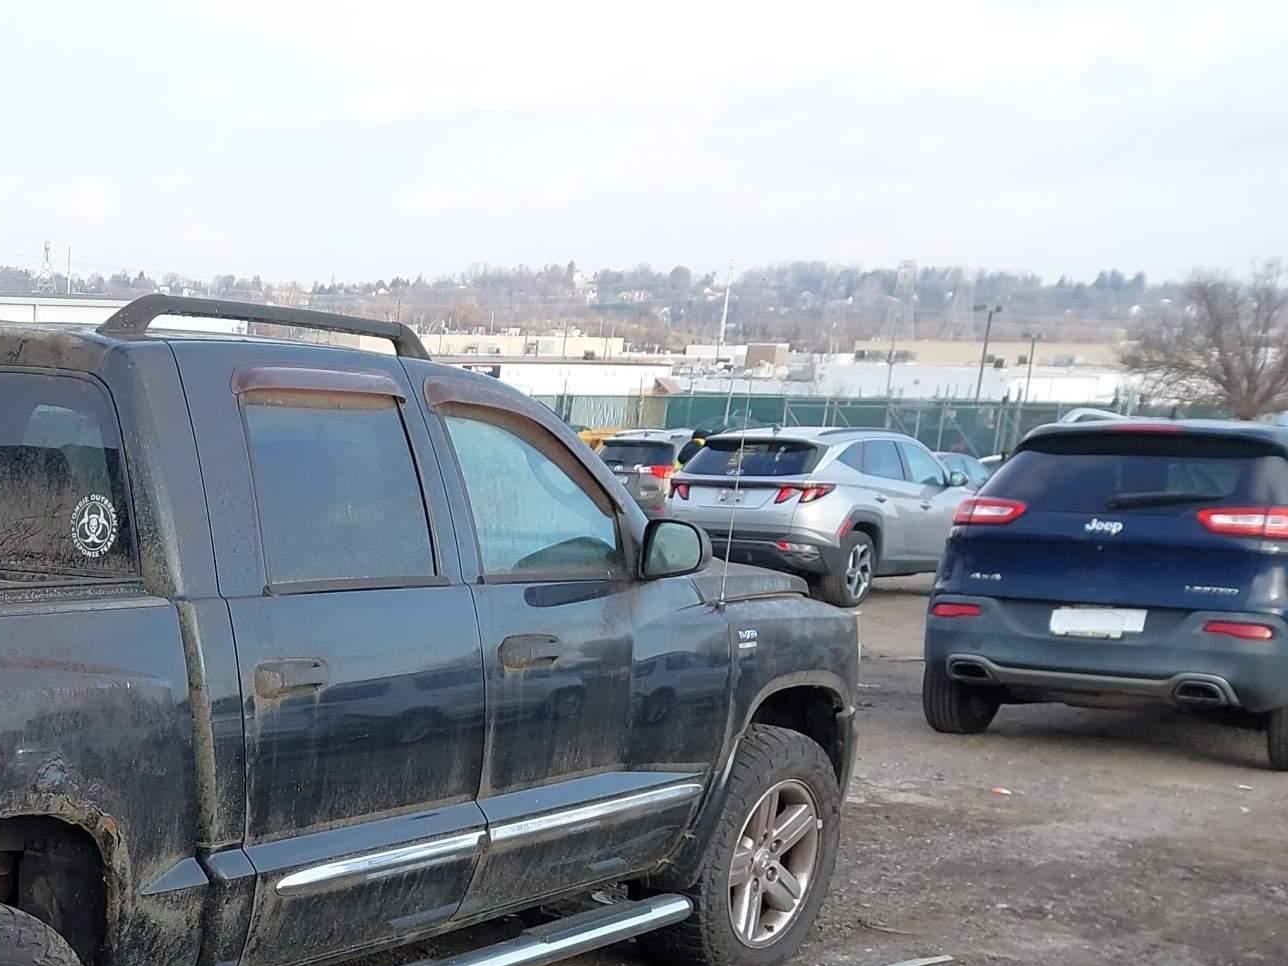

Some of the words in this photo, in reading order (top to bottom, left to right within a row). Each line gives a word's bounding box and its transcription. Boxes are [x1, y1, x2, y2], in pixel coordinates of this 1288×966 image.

[71, 496, 89, 525] ZOMBIE
[90, 494, 118, 526] OUTBREAK
[1085, 518, 1123, 535] Jeep
[72, 532, 100, 557] RESPONSE
[100, 533, 116, 555] TEAM
